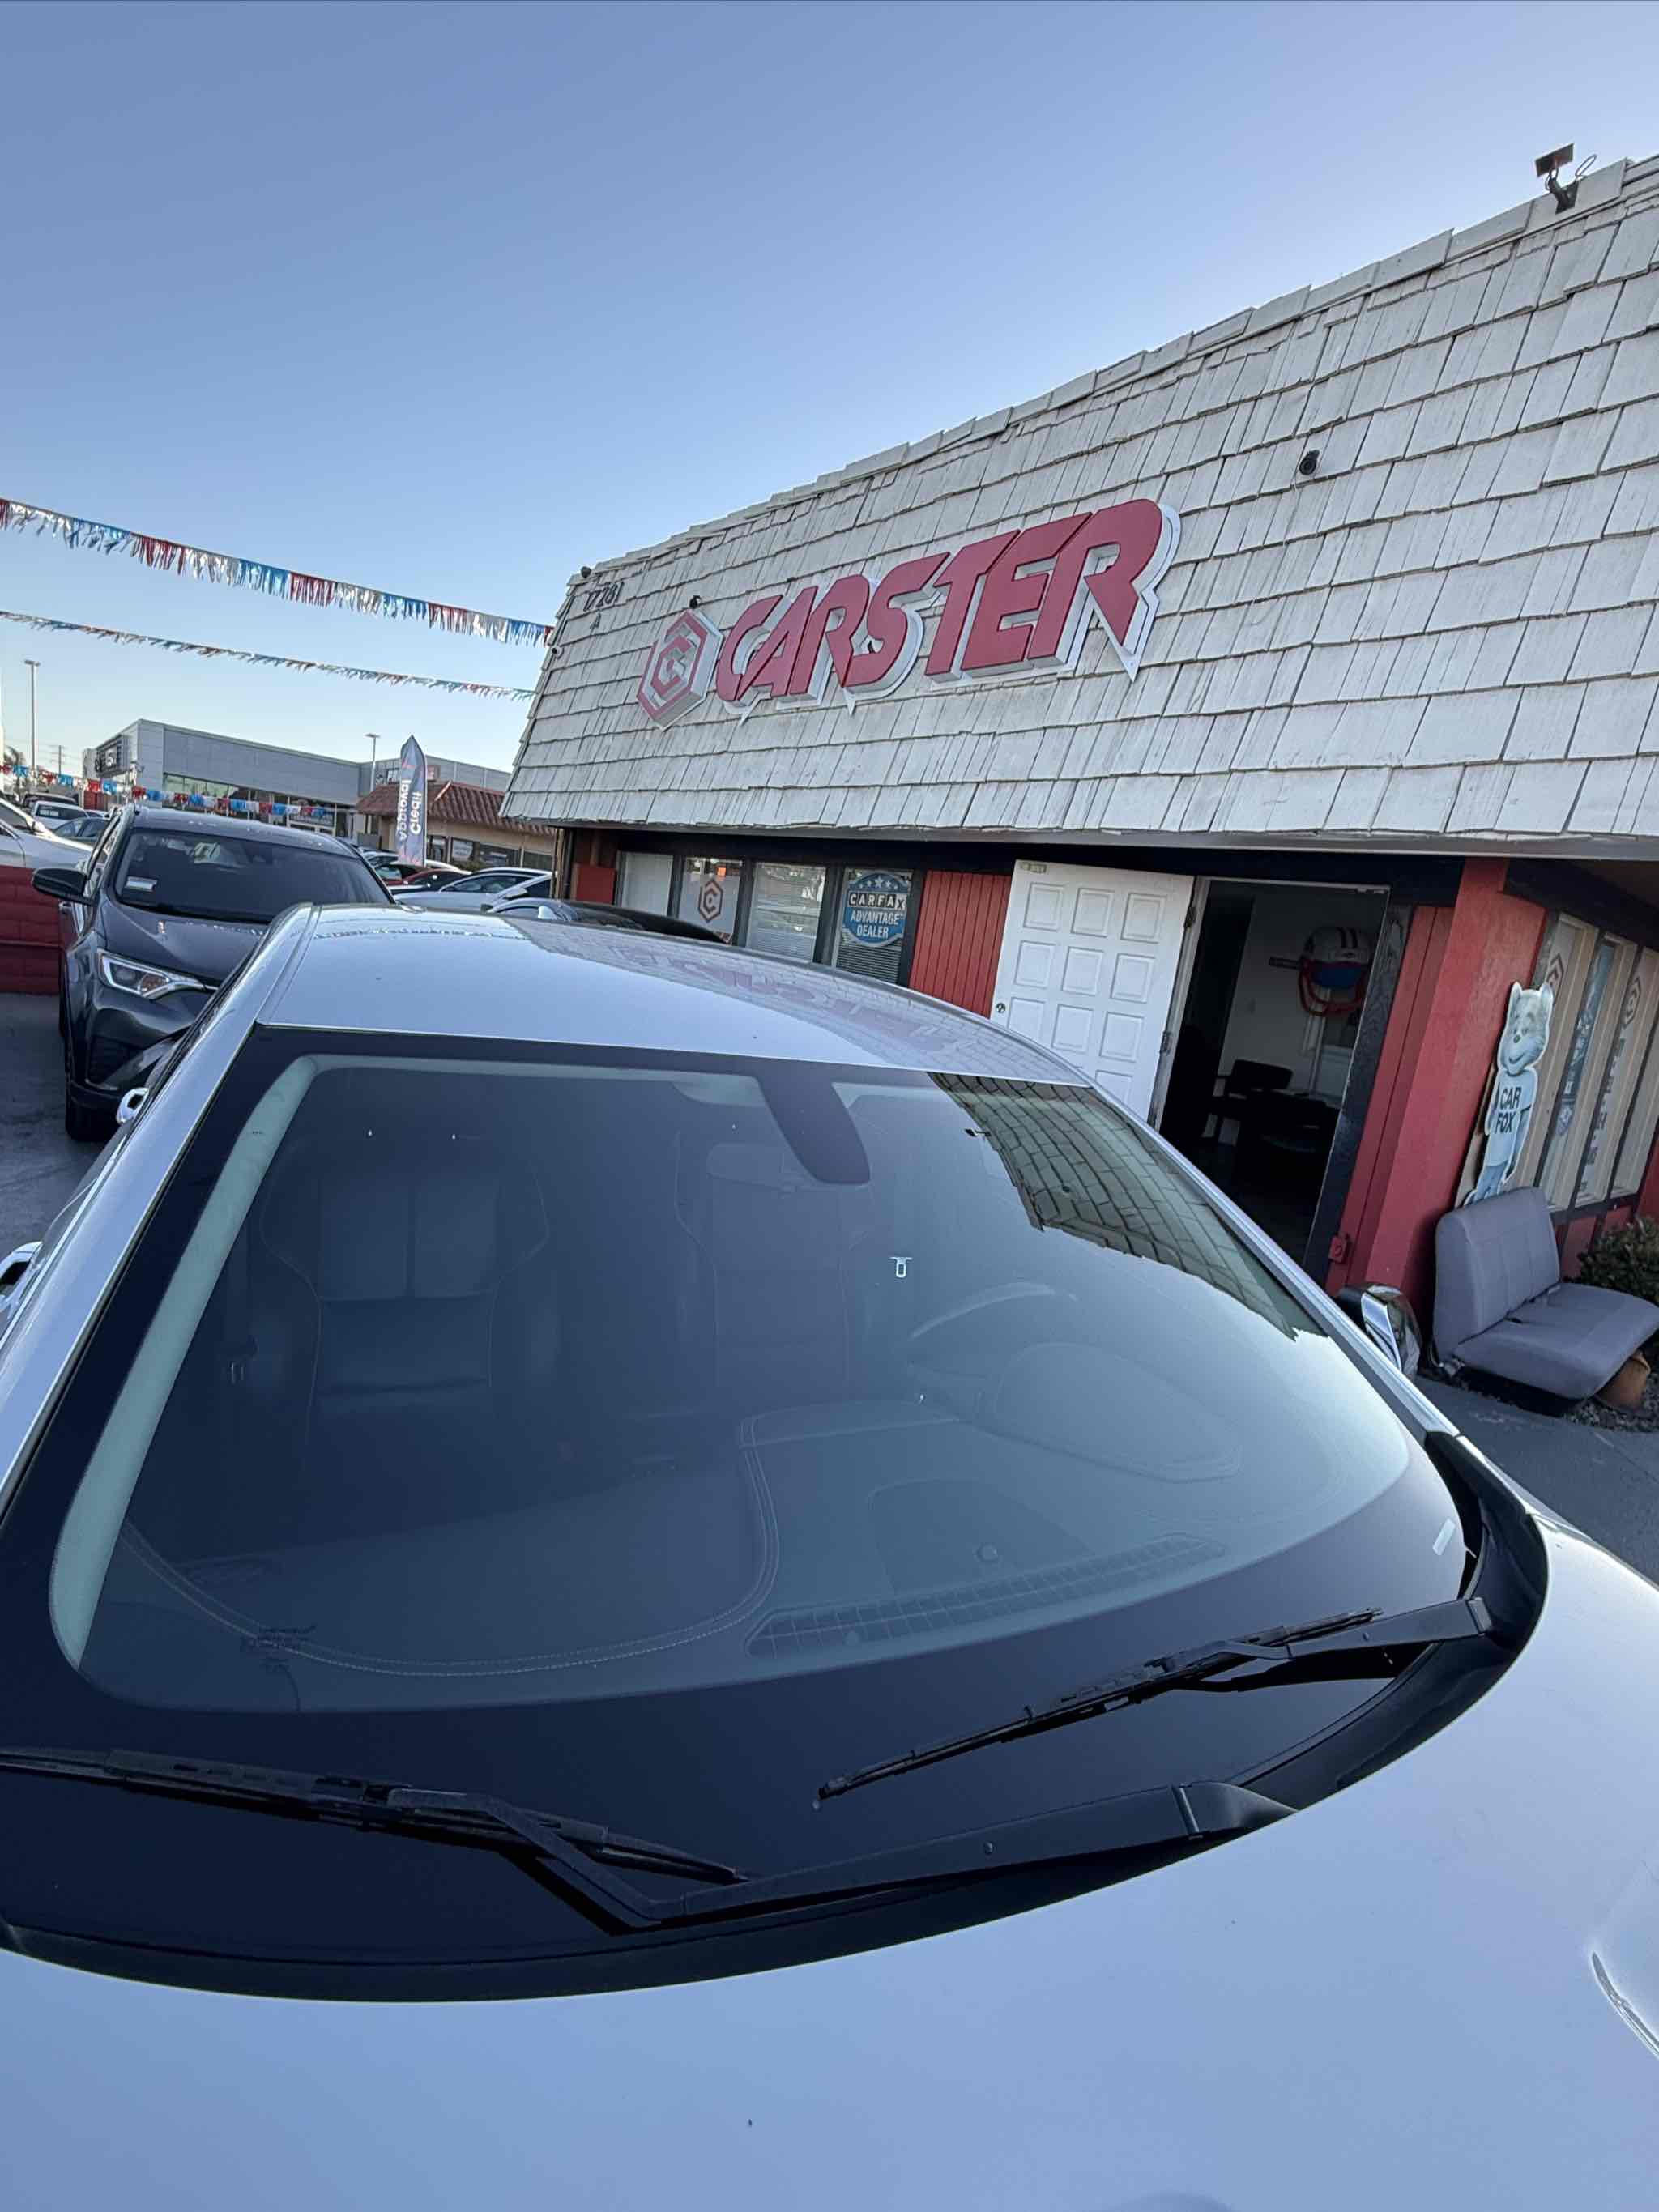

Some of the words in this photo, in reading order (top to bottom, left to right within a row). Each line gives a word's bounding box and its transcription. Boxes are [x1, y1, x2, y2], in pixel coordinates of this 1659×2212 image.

[715, 499, 1164, 702] CARSTER
[849, 892, 906, 910] CARFAX
[850, 909, 899, 925] ADVANTAGE
[856, 923, 889, 939] DEALER
[1499, 1086, 1522, 1110] CAR
[1494, 1111, 1516, 1134] FOX
